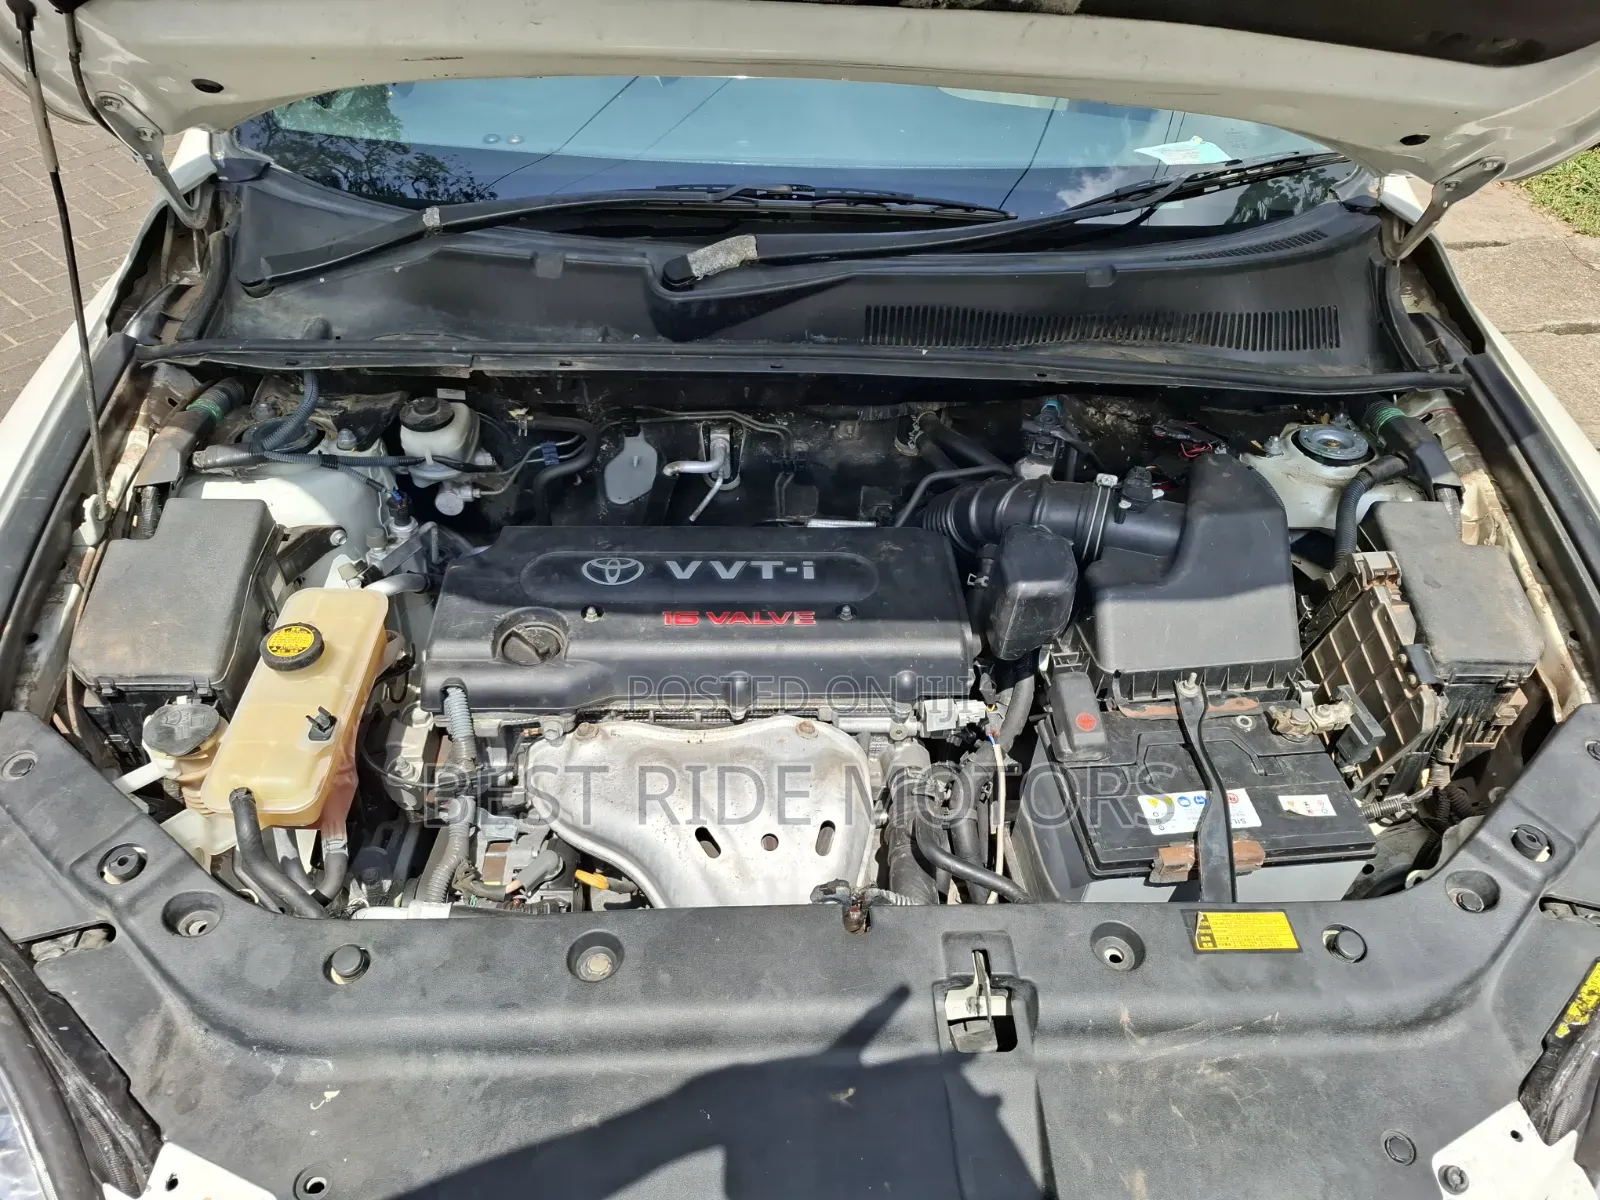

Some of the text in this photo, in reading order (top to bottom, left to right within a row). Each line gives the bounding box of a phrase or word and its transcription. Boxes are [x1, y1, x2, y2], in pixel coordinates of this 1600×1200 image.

[665, 560, 815, 580] VVT-i
[662, 611, 817, 626] 16 VALVE
